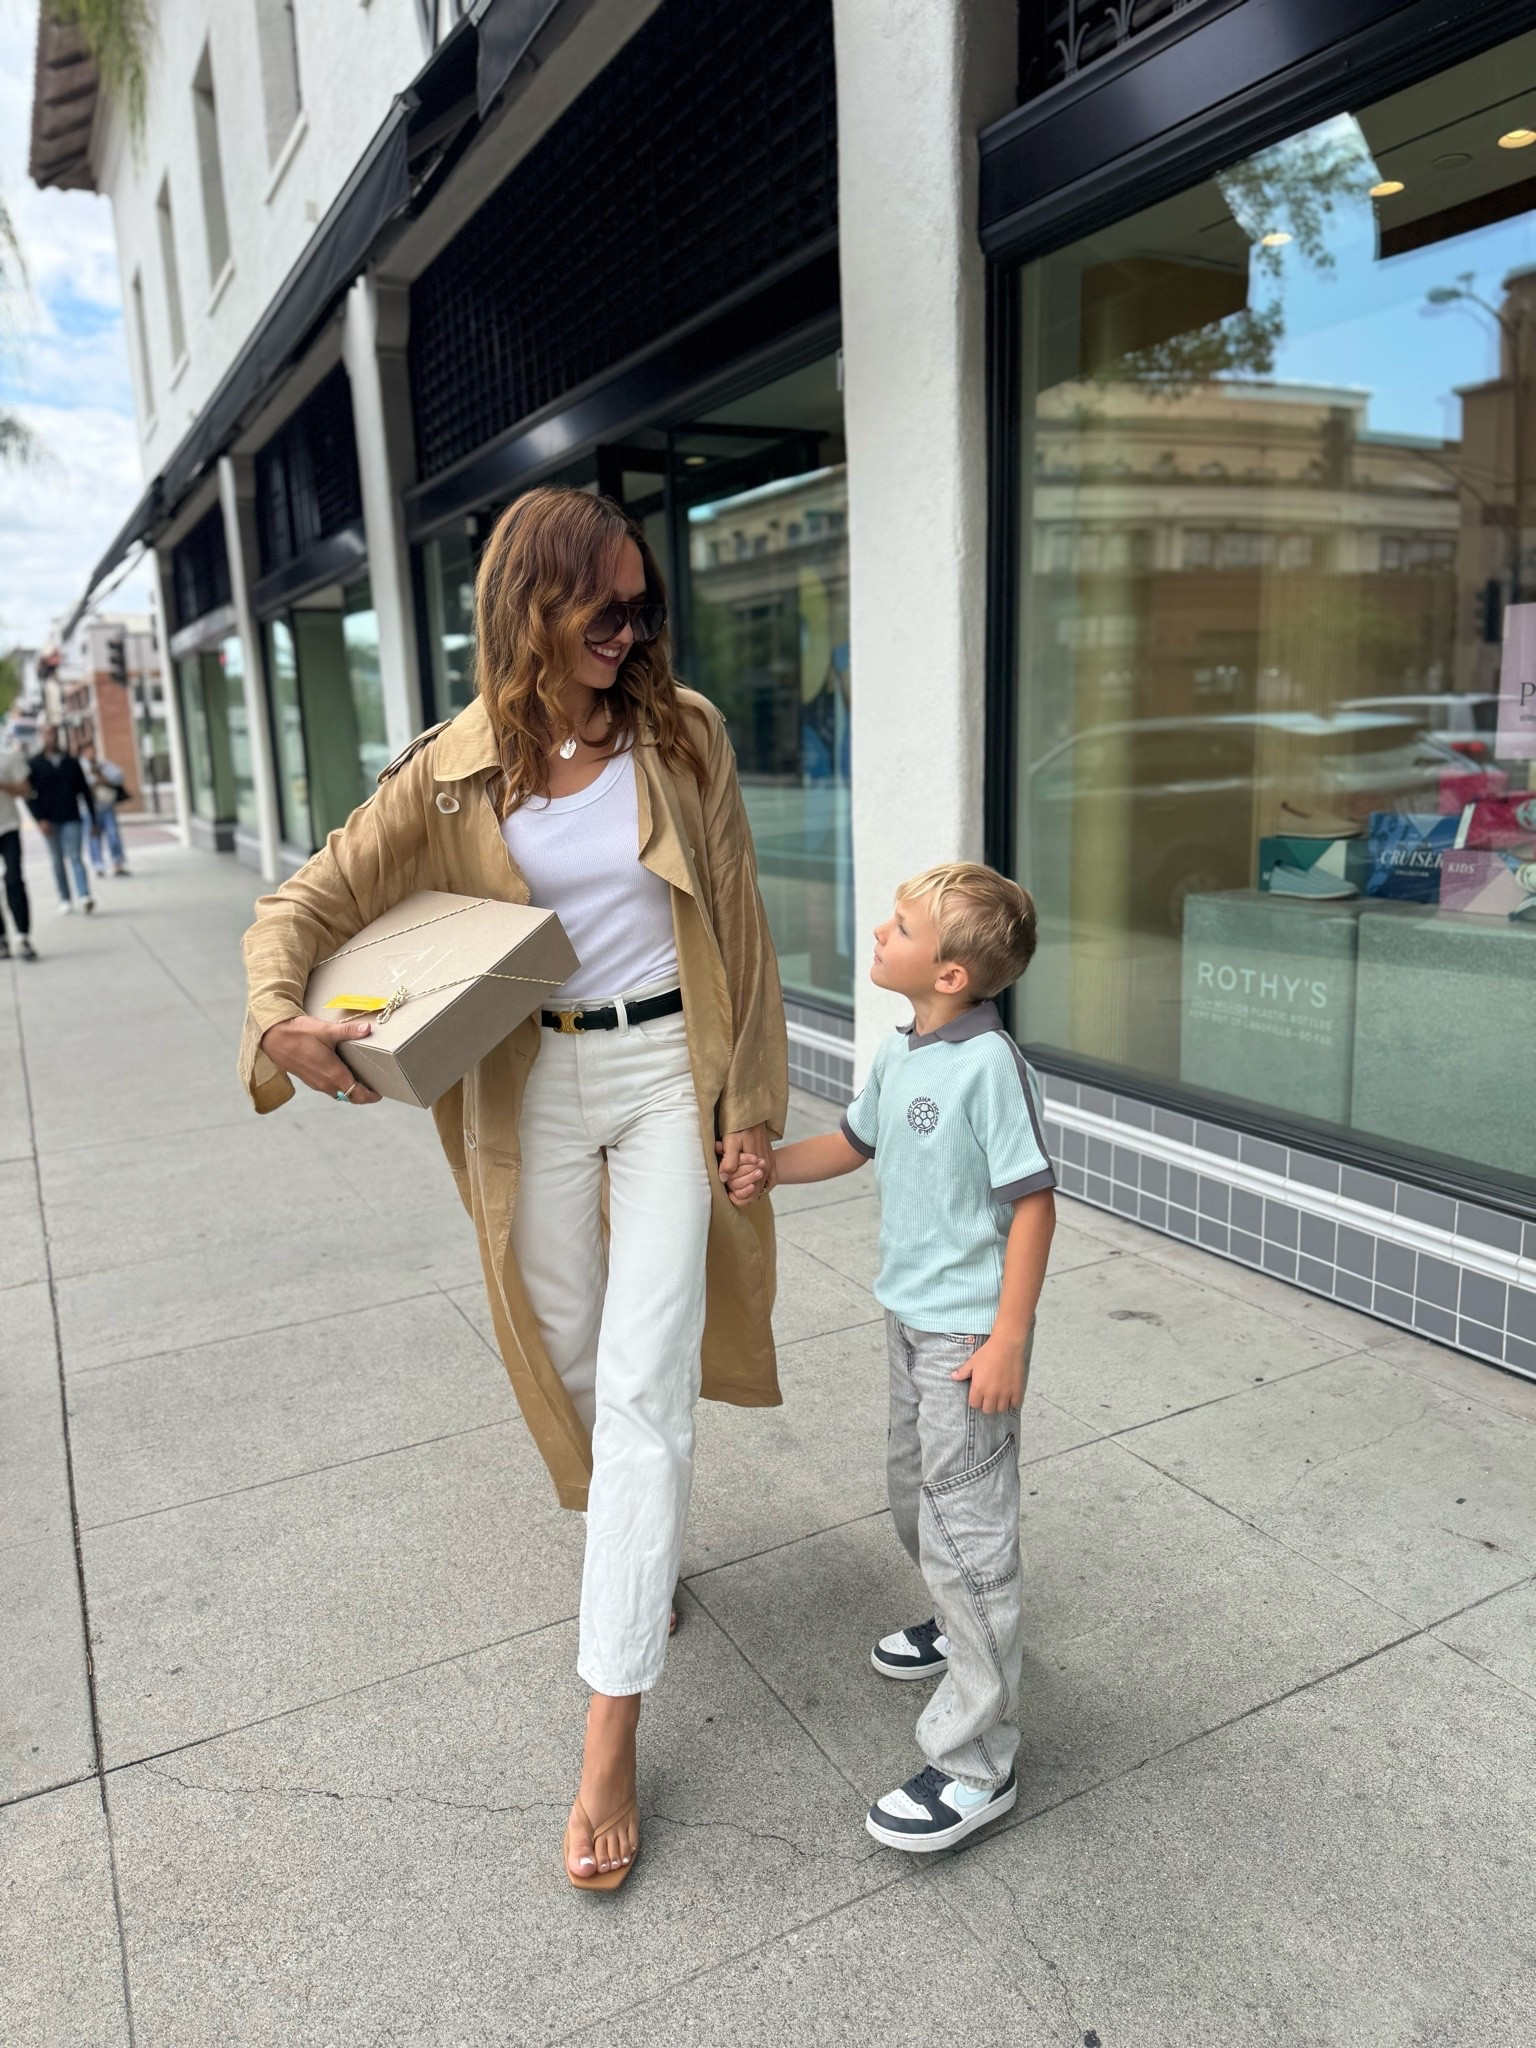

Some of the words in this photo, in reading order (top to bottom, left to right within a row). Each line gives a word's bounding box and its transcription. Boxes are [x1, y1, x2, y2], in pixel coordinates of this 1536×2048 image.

[1448, 862, 1475, 875] KIDS
[1198, 961, 1327, 1009] ROTHY'S
[1290, 1013, 1332, 1031] BOTTLES
